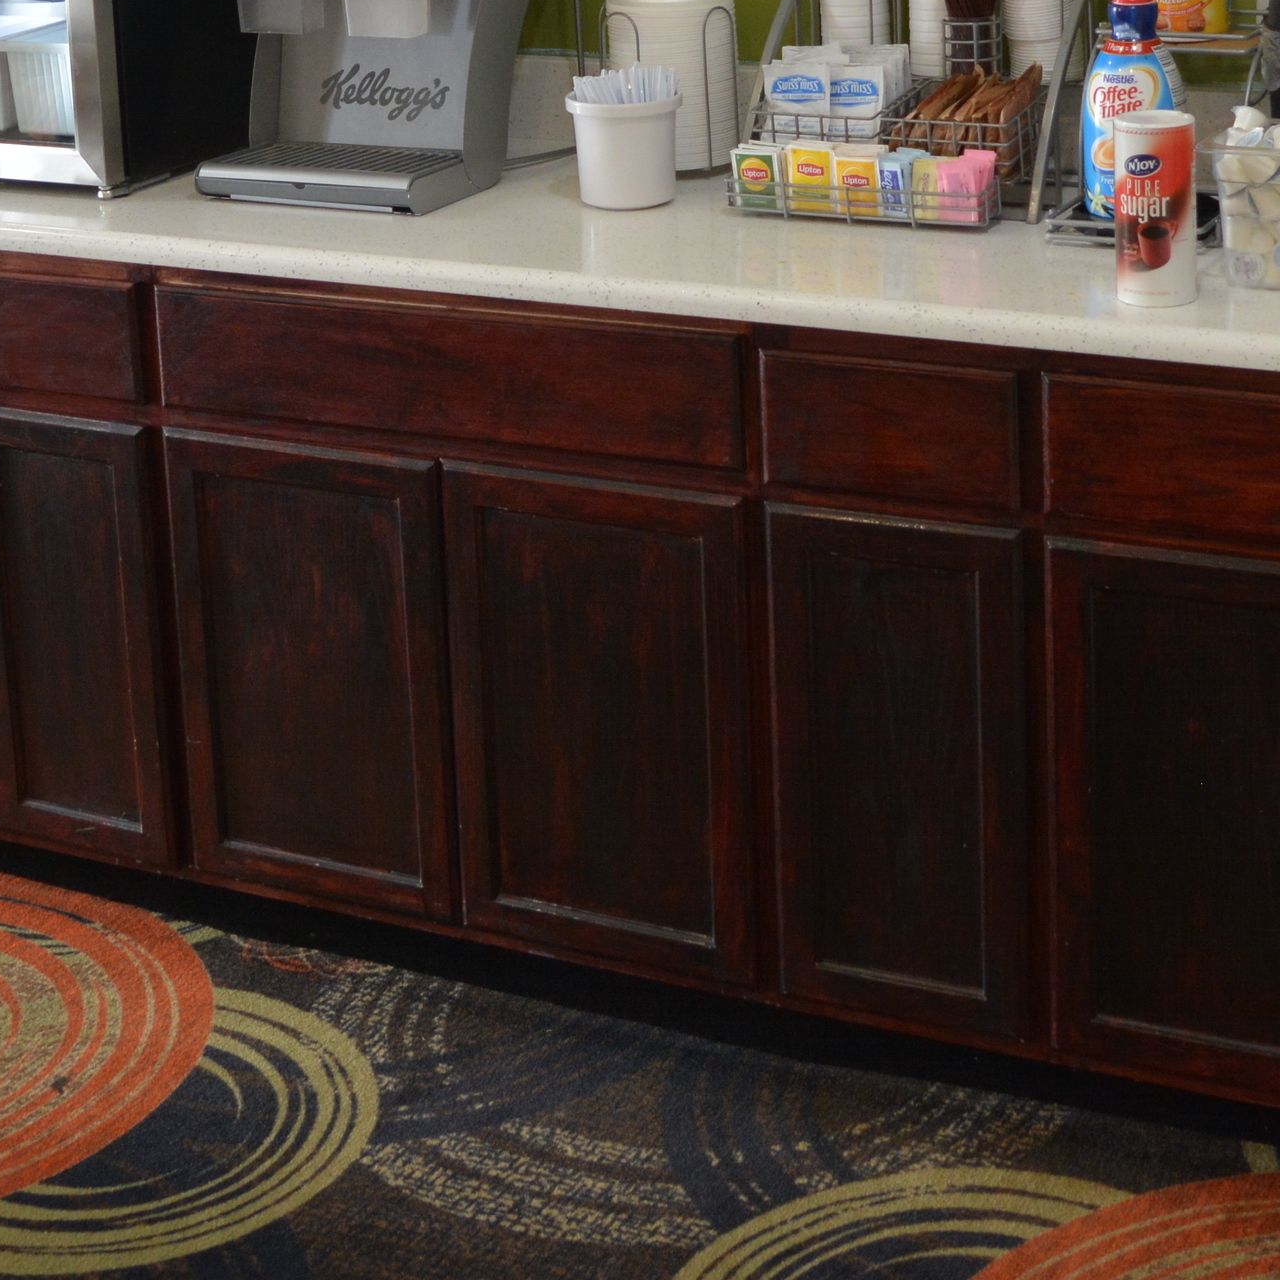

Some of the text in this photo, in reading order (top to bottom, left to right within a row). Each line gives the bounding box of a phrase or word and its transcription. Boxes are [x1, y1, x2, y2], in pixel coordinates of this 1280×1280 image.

[320, 63, 451, 121] Kellogg's
[1100, 99, 1143, 119] mate
[743, 169, 767, 178] Lipton
[799, 165, 823, 175] Lipton
[843, 176, 868, 186] Lipton
[1126, 178, 1161, 197] PURE
